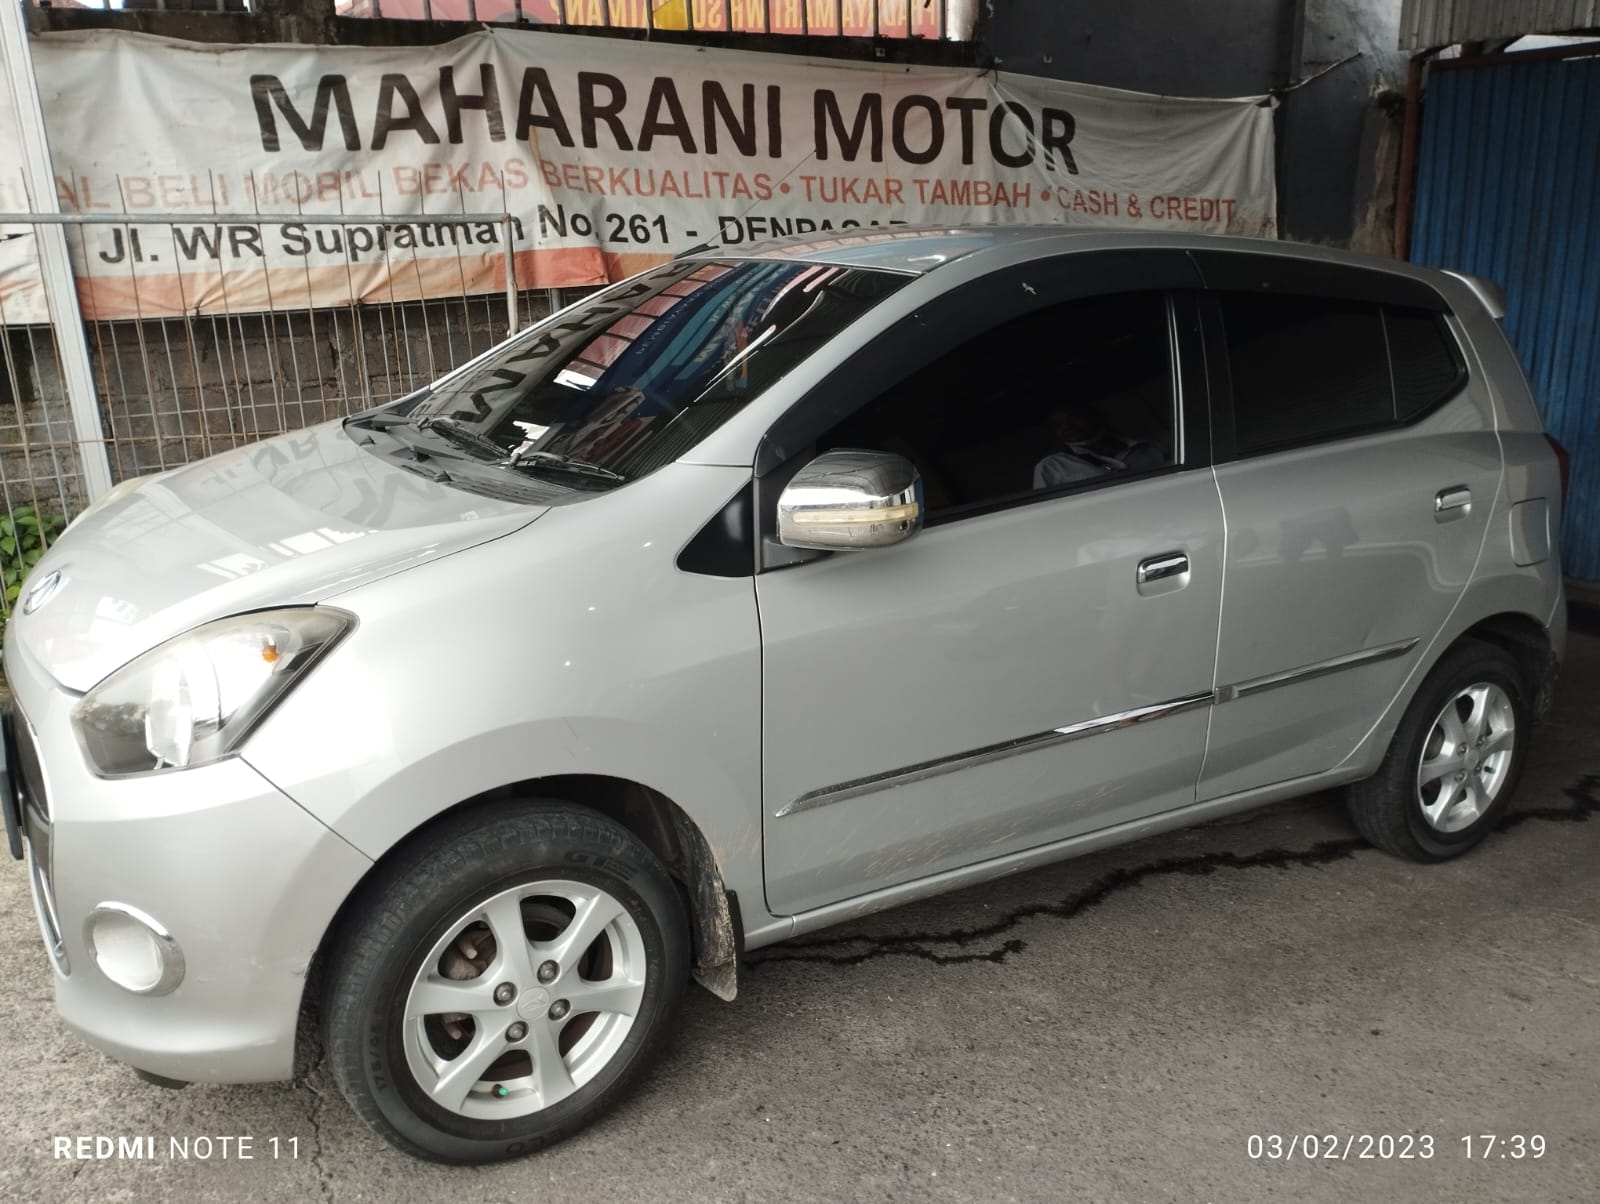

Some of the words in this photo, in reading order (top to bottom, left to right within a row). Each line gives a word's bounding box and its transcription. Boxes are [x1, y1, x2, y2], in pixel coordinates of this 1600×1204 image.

[249, 63, 782, 158] MAHARANI
[813, 88, 1079, 175] MOTOR
[122, 173, 230, 209] BELI
[243, 170, 379, 205] MOBIL
[392, 158, 528, 195] BEKAS
[539, 159, 773, 201] BERKUALITAS
[799, 175, 904, 205] TUKAR
[912, 178, 1031, 208] TAMBAH
[1056, 186, 1118, 216] CASH
[1127, 193, 1142, 218] &
[1150, 195, 1236, 223] CREDIT
[172, 225, 263, 260] WR
[280, 214, 525, 262] Supratman
[605, 213, 669, 244] 261
